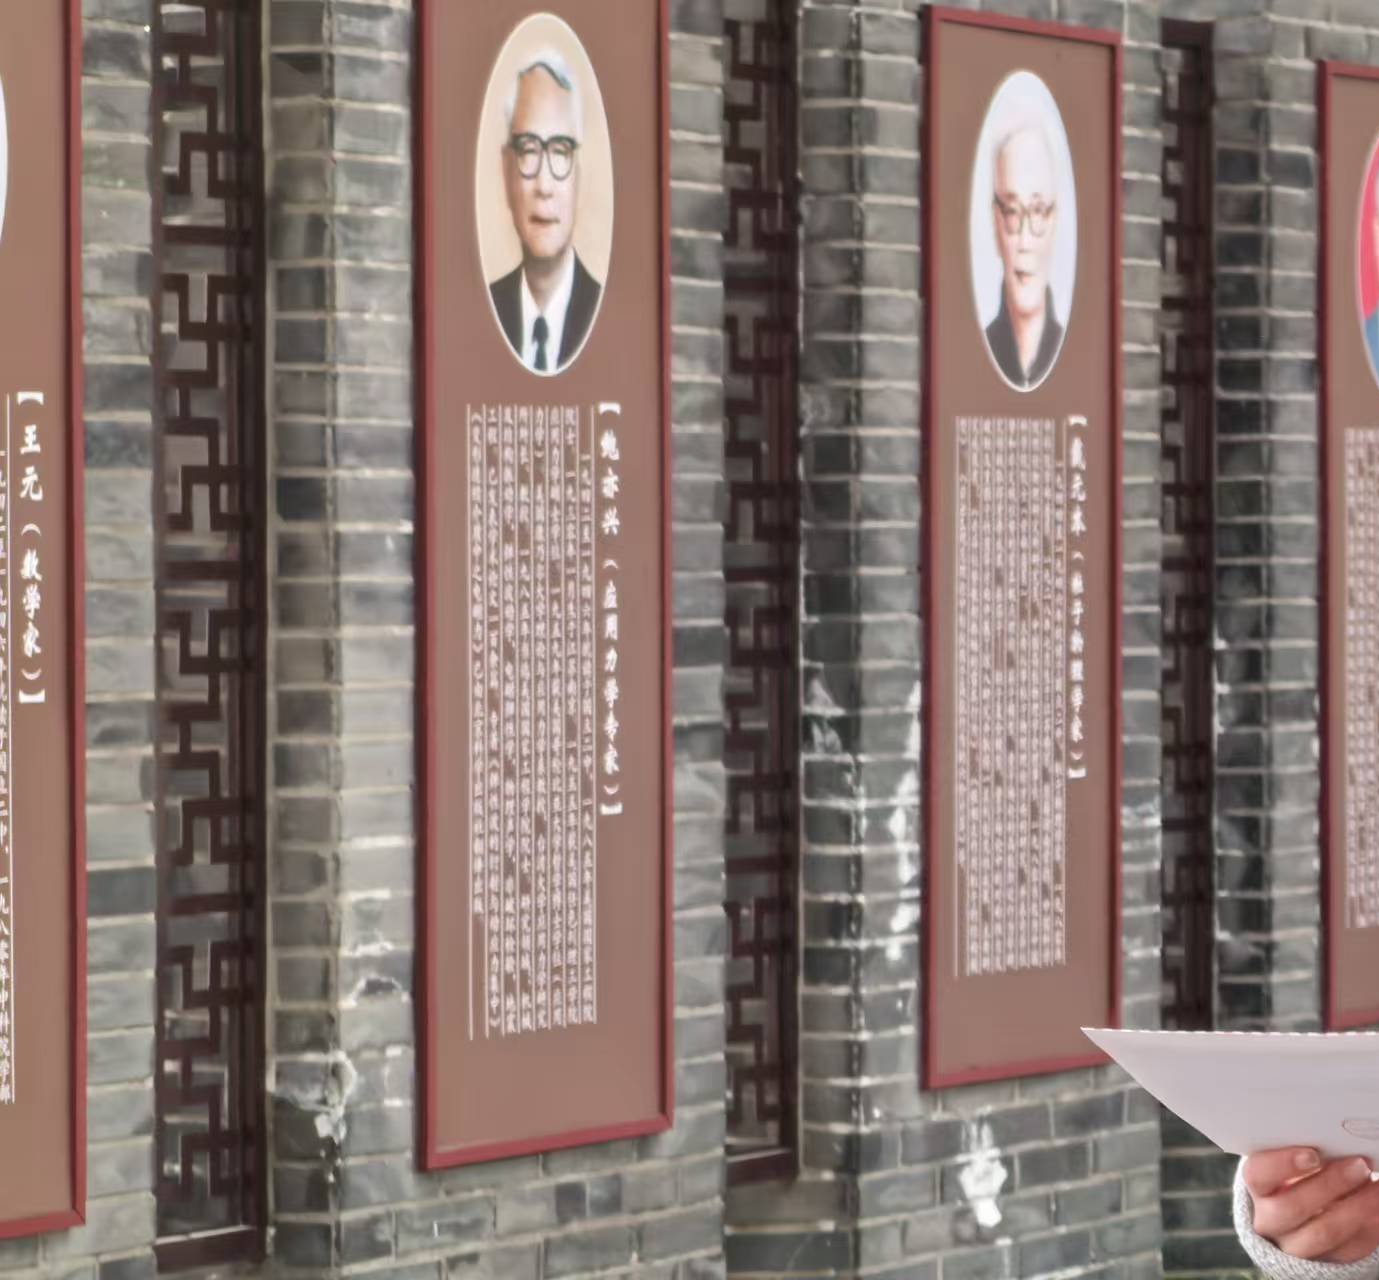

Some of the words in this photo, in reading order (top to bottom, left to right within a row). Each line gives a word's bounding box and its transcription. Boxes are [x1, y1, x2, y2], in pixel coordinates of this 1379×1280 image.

[17, 391, 46, 704] 【王元（数学家）】
[598, 402, 623, 815] 【鲍亦兴（应用力学专家）】
